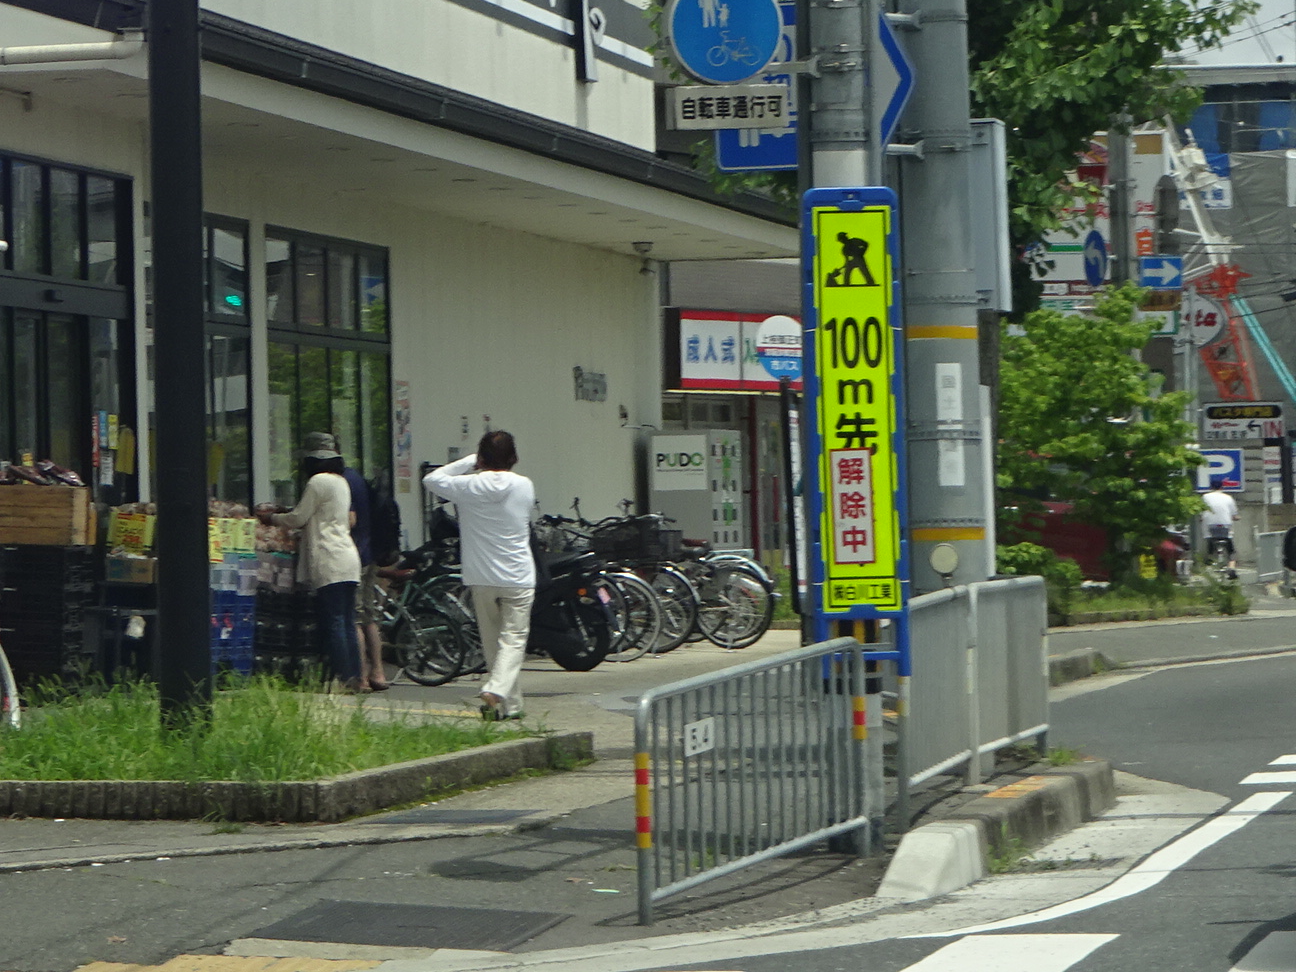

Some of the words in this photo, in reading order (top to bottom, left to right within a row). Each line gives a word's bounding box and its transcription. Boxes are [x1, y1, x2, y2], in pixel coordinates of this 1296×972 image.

[681, 95, 783, 120] 自転車通行可
[656, 452, 704, 468] PUDO
[837, 457, 868, 554] 解除中
